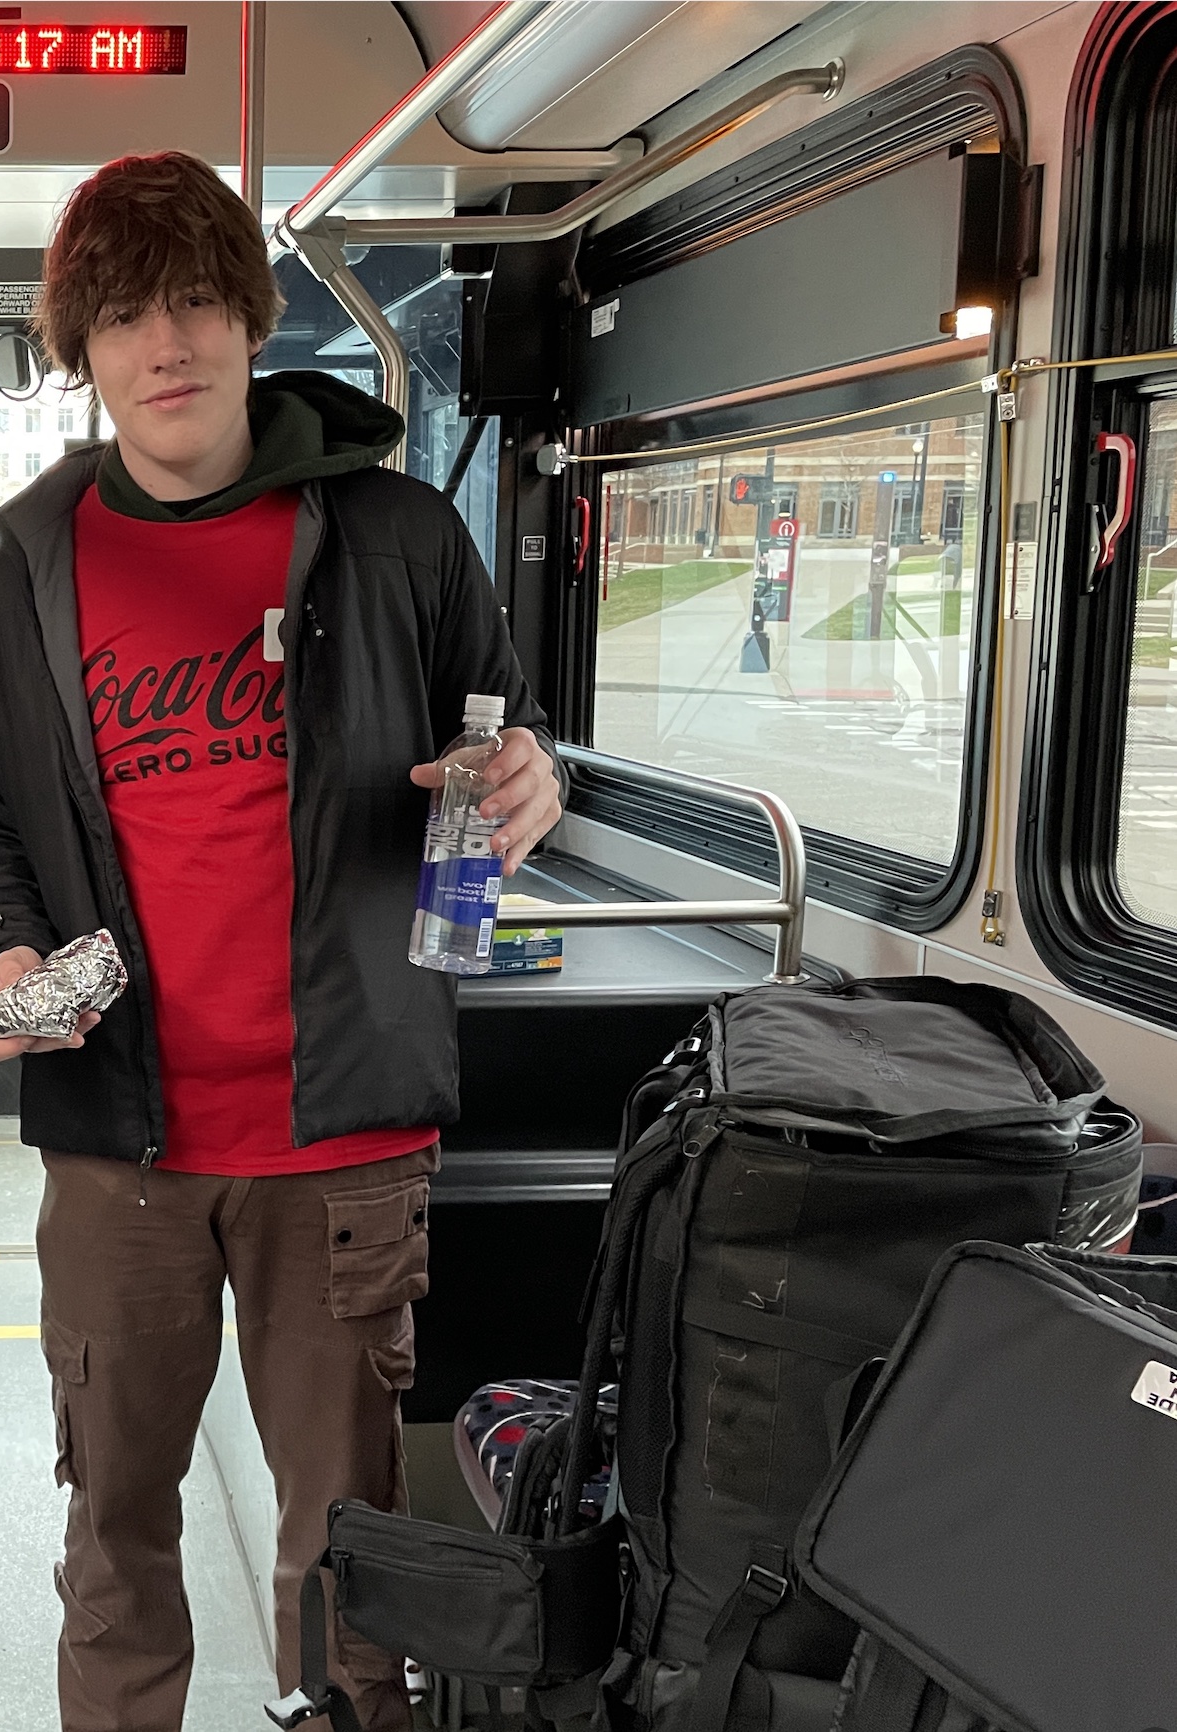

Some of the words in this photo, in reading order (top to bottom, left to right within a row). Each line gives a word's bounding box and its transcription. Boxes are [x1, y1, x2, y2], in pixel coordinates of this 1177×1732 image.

[90, 28, 143, 68] AM
[102, 748, 192, 785] ERO
[208, 731, 288, 765] SUG
[444, 893, 479, 903] great
